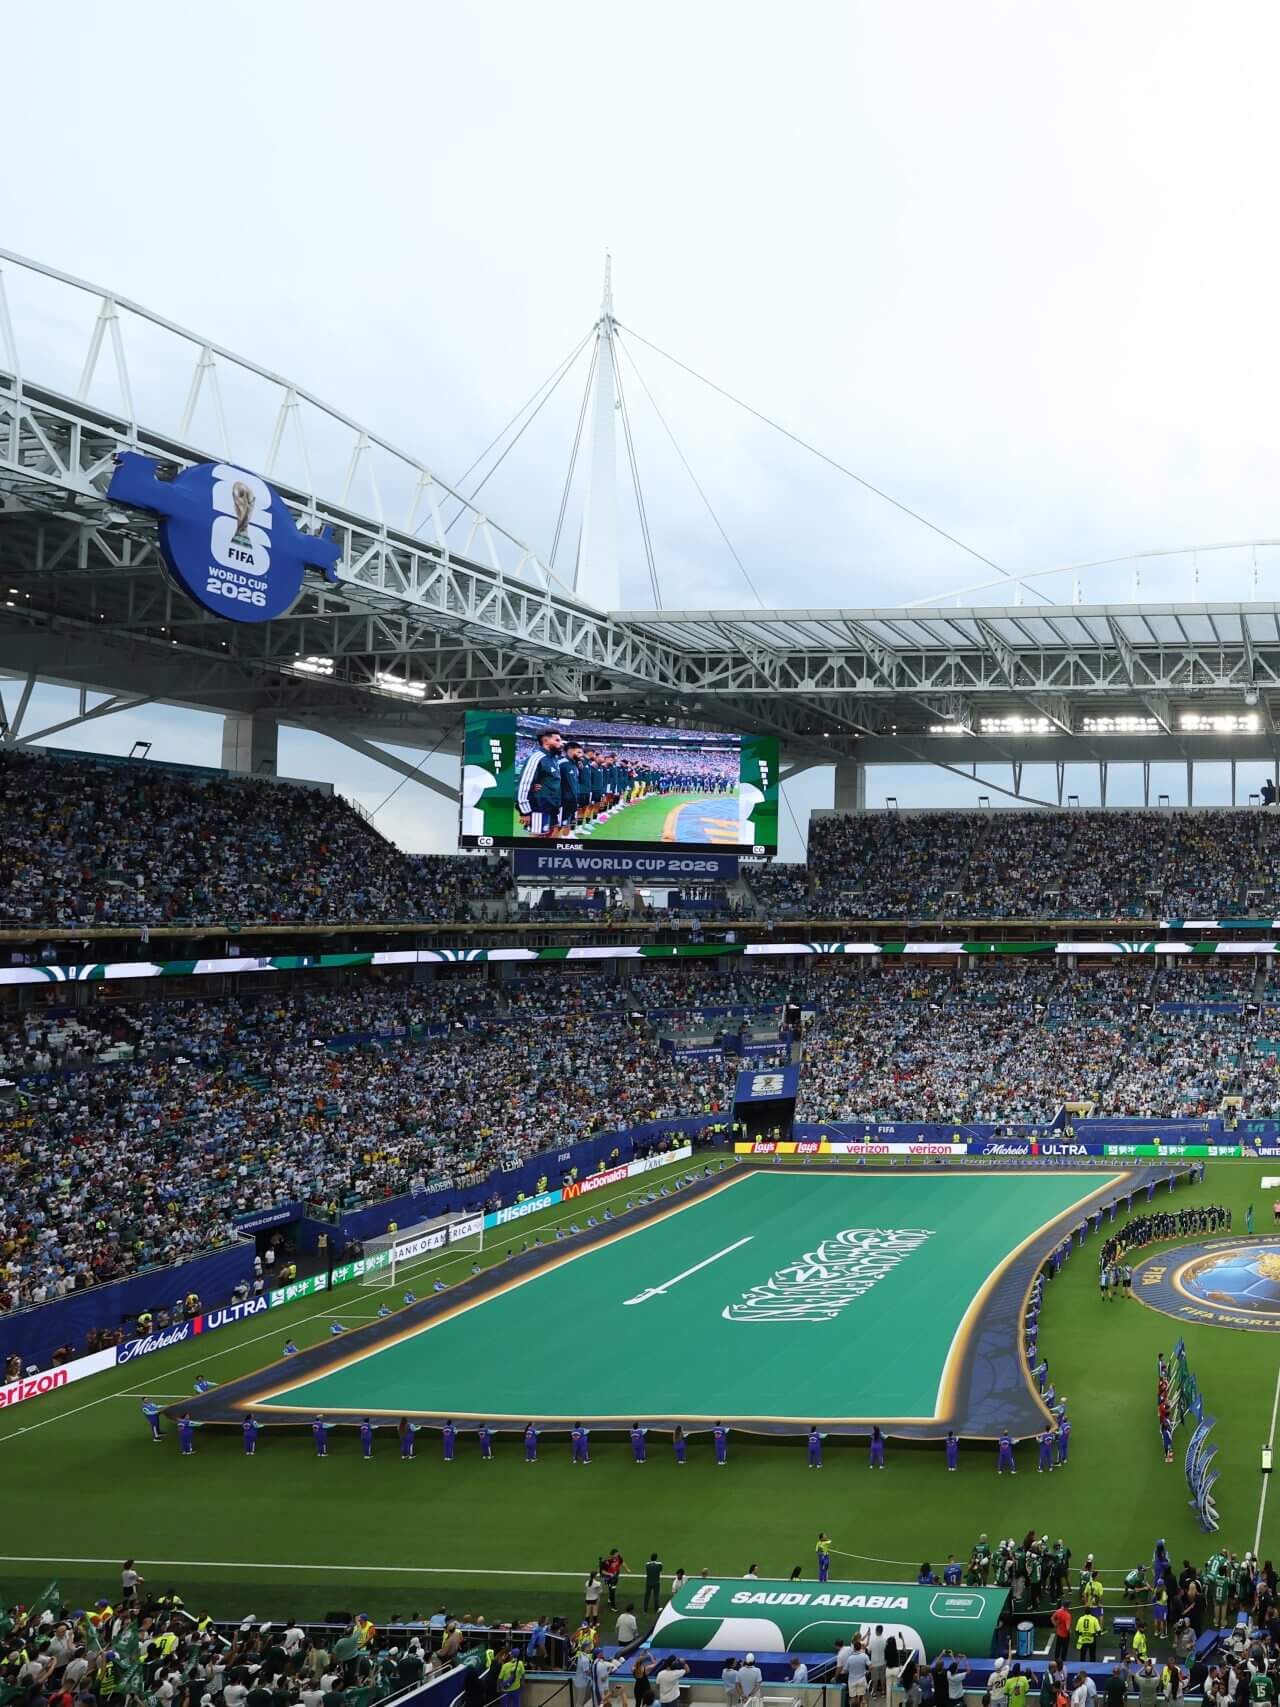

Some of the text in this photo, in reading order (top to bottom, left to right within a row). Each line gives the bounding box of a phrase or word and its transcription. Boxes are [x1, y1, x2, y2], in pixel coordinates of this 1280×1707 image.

[228, 548, 254, 565] FIFA
[208, 566, 268, 590] WORLD CUP
[206, 578, 267, 607] 2026
[537, 856, 719, 872] FIFA WORLD CUP 2026
[878, 1126, 895, 1134] FIFA
[846, 1145, 889, 1154] verizon
[909, 1145, 952, 1154] verizon
[982, 1143, 1088, 1155] Michelob ULTRA
[557, 1152, 571, 1163] FIFA
[580, 1168, 627, 1193] McDonald's
[497, 1195, 551, 1224] Hisense
[244, 1219, 263, 1229] WORLD
[421, 1239, 433, 1250] OF
[1142, 1266, 1167, 1286] FIFA
[1179, 1306, 1214, 1319] FIFA
[118, 1297, 267, 1363] Michelob ULTRA
[0, 1369, 67, 1408] erizon
[731, 1591, 908, 1609] SAUDI ARABIA
[1257, 1685, 1265, 1697] 15
